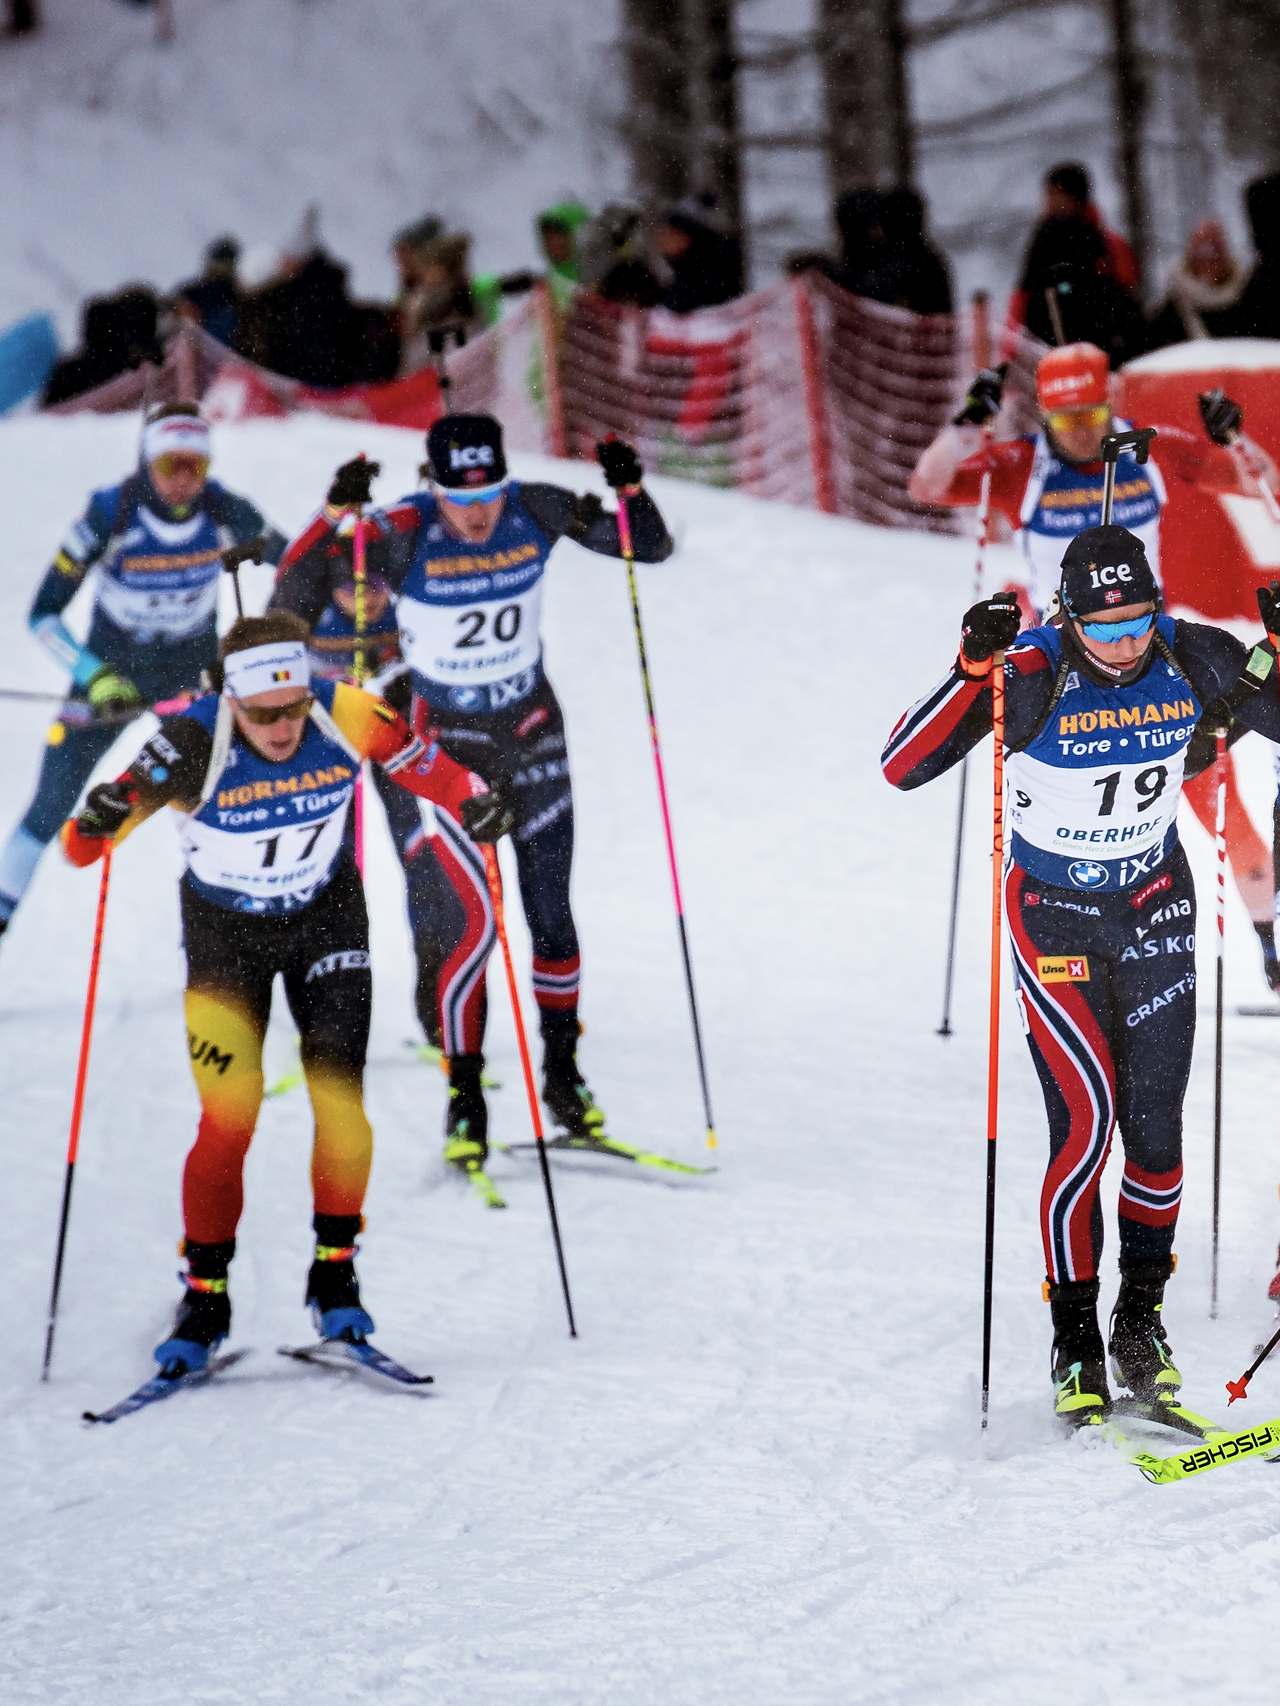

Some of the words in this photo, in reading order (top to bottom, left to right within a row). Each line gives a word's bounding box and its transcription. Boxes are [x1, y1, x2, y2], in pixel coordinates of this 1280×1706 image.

[1090, 561, 1134, 589] ice
[455, 604, 522, 649] 20
[1059, 698, 1196, 736] HÖRMANN
[1058, 739, 1112, 756] Tore
[1016, 789, 1032, 809] 9
[1093, 765, 1169, 817] 19
[217, 806, 269, 826] Tore
[1056, 815, 1163, 844] OBERHOF
[254, 821, 330, 869] 17
[1119, 840, 1165, 886] iX3
[1042, 964, 1066, 975] Uno
[1126, 979, 1186, 1028] CRAFT
[1178, 1426, 1273, 1473] FISCHER
